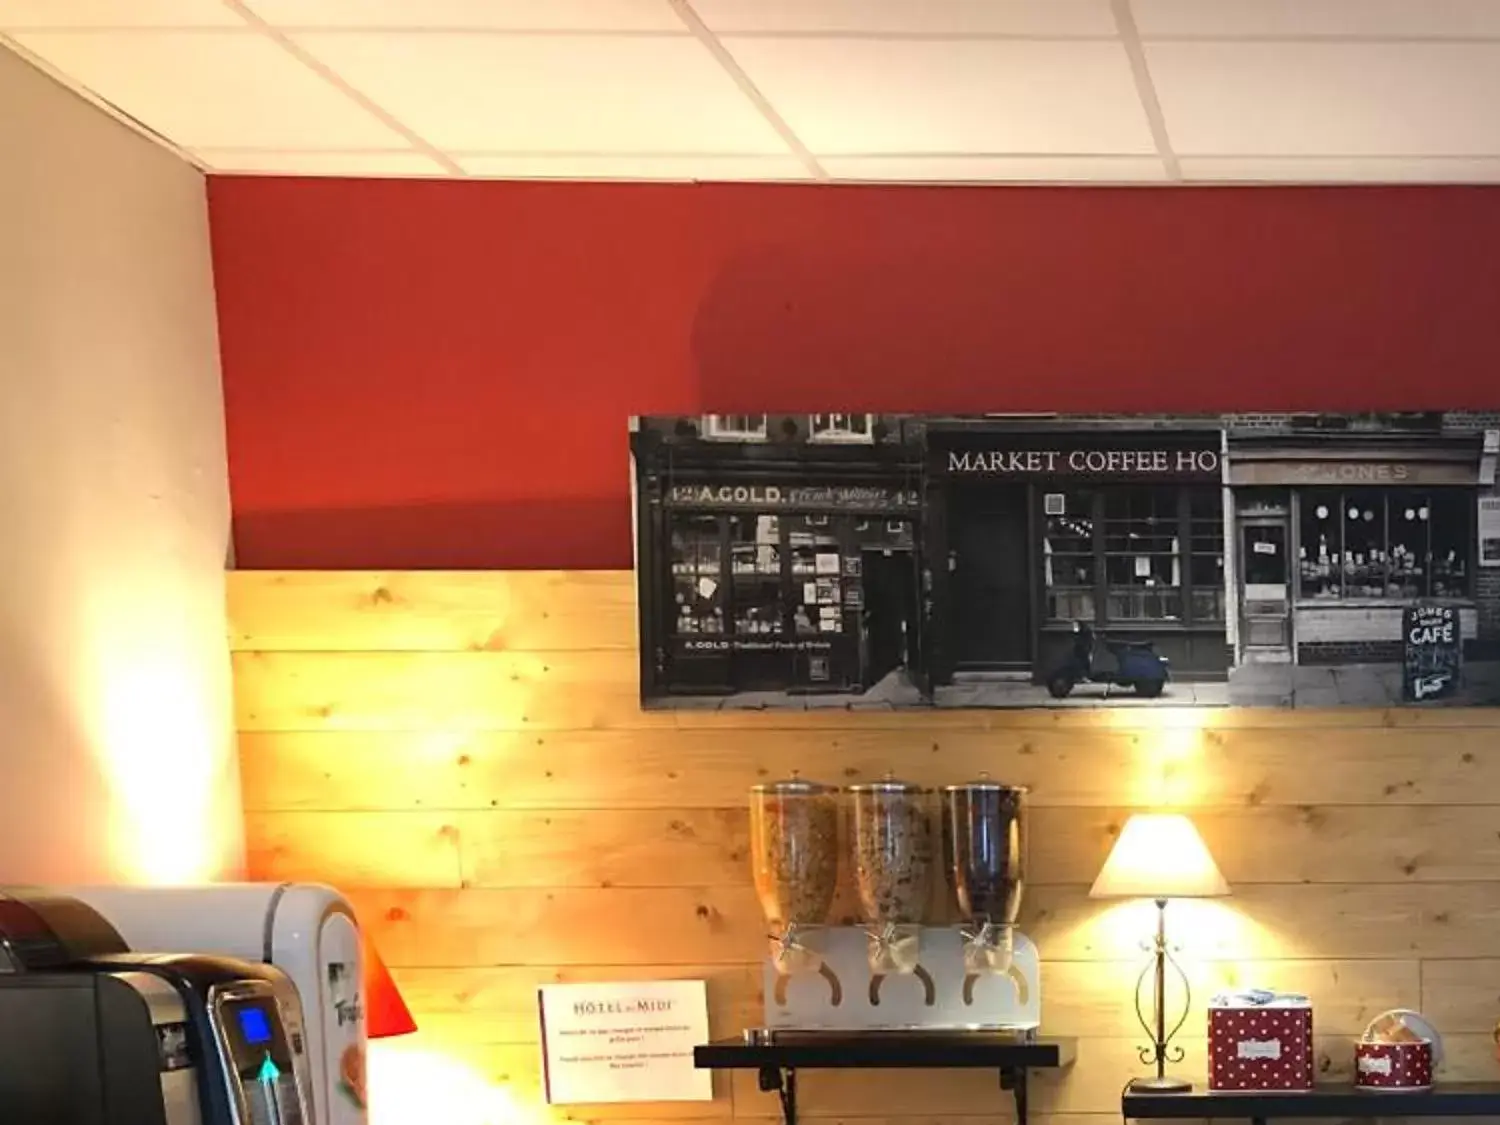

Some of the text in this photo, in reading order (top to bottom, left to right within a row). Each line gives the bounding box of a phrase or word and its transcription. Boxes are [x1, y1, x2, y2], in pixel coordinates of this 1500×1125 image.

[948, 450, 1218, 472] MARKET COFFEE HO
